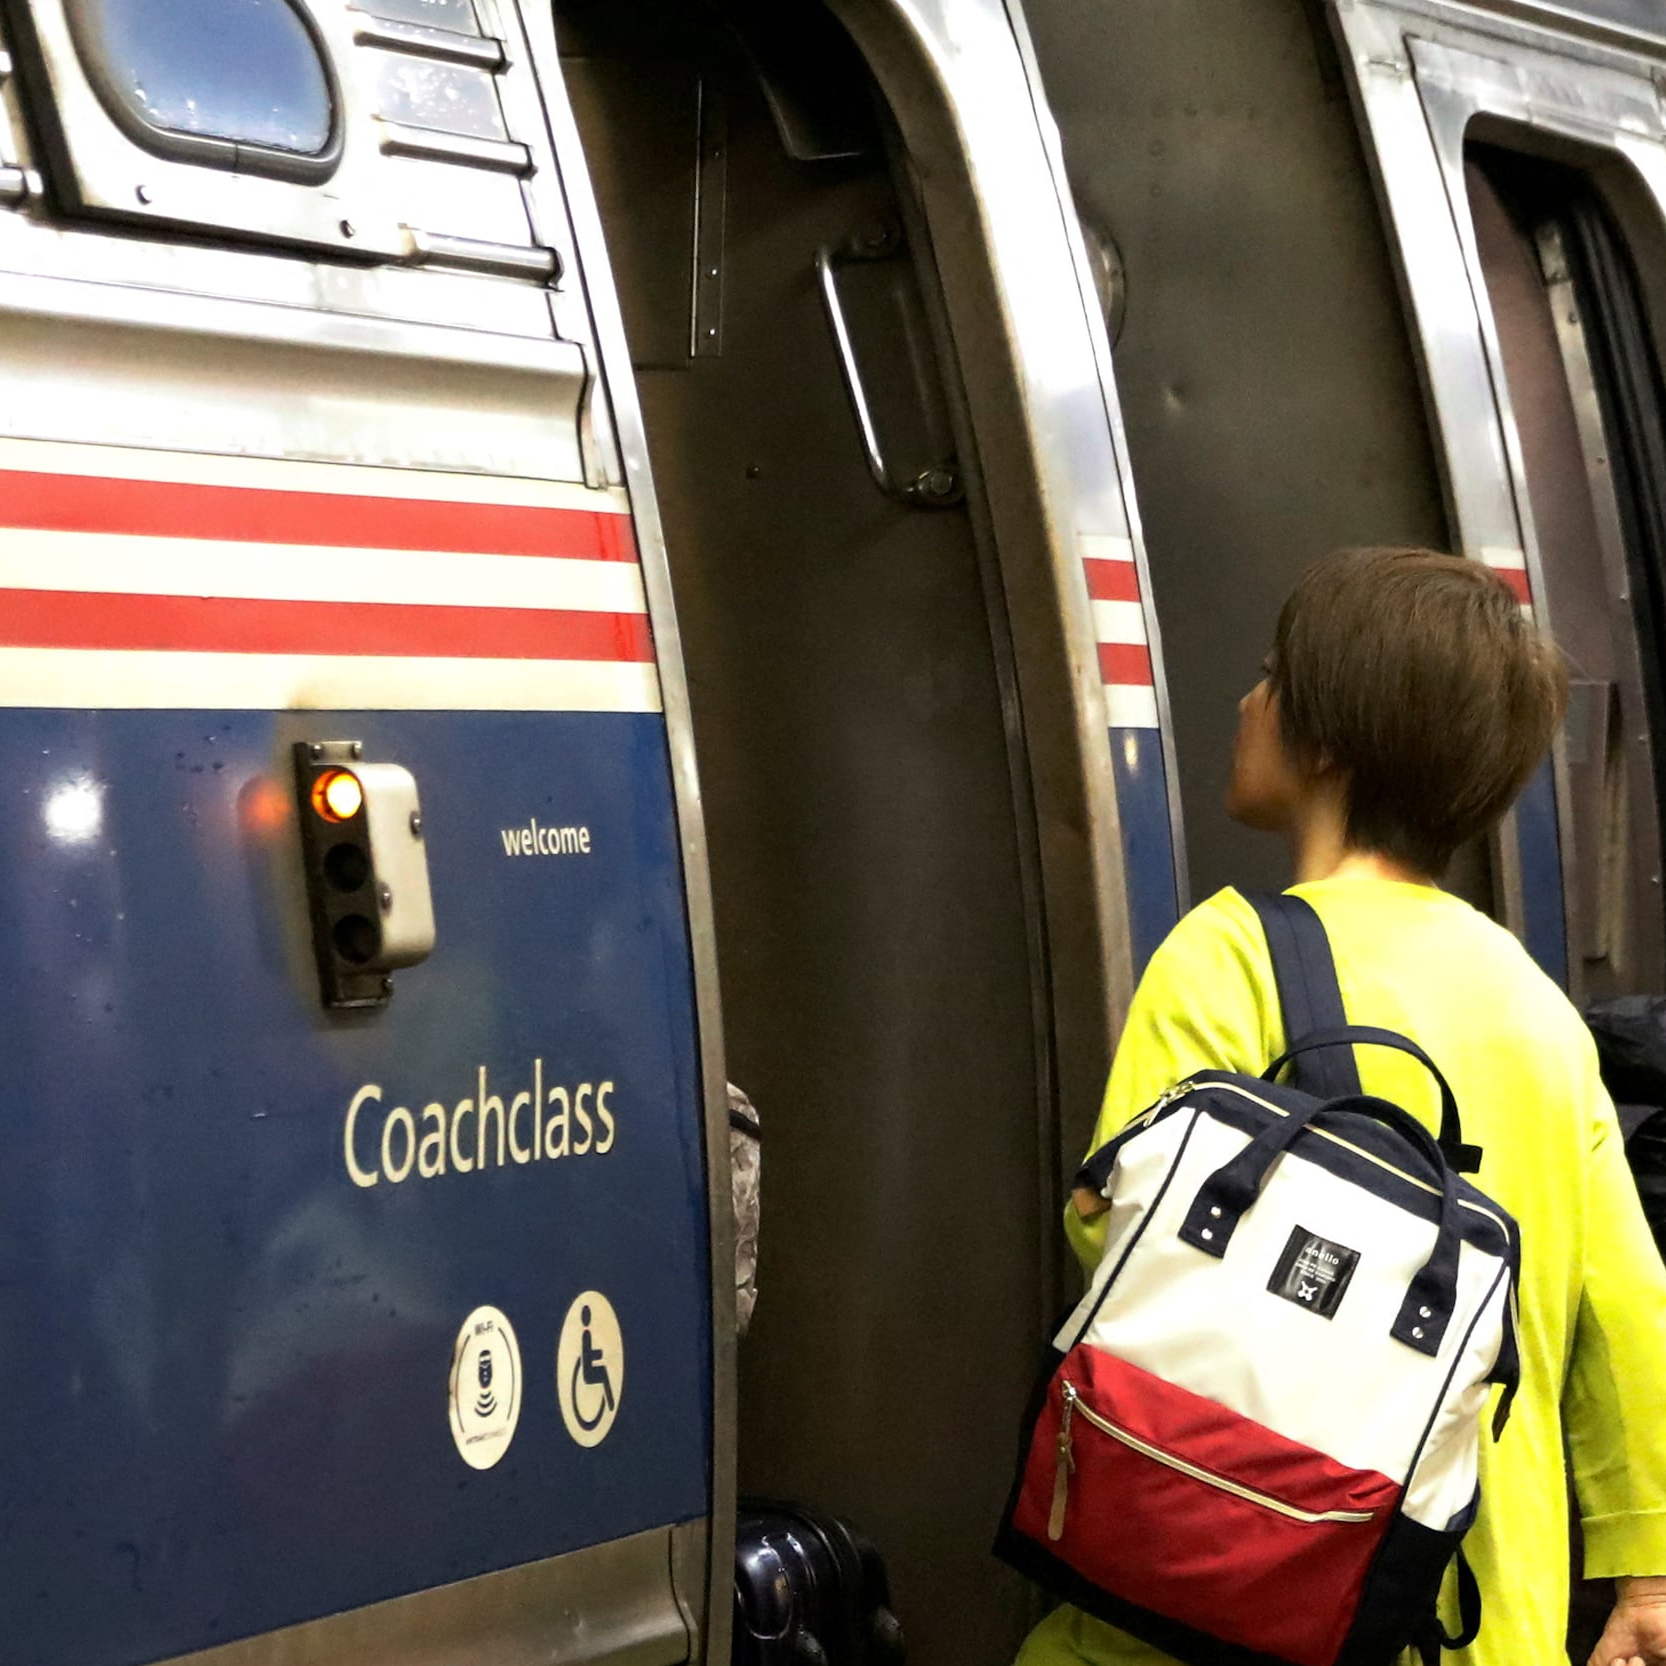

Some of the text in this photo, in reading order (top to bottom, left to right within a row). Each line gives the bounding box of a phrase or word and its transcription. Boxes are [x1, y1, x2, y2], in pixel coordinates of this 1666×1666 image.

[501, 818, 591, 857] welcome
[344, 1059, 616, 1188] Coachclass
[1304, 1246, 1340, 1266] anello
